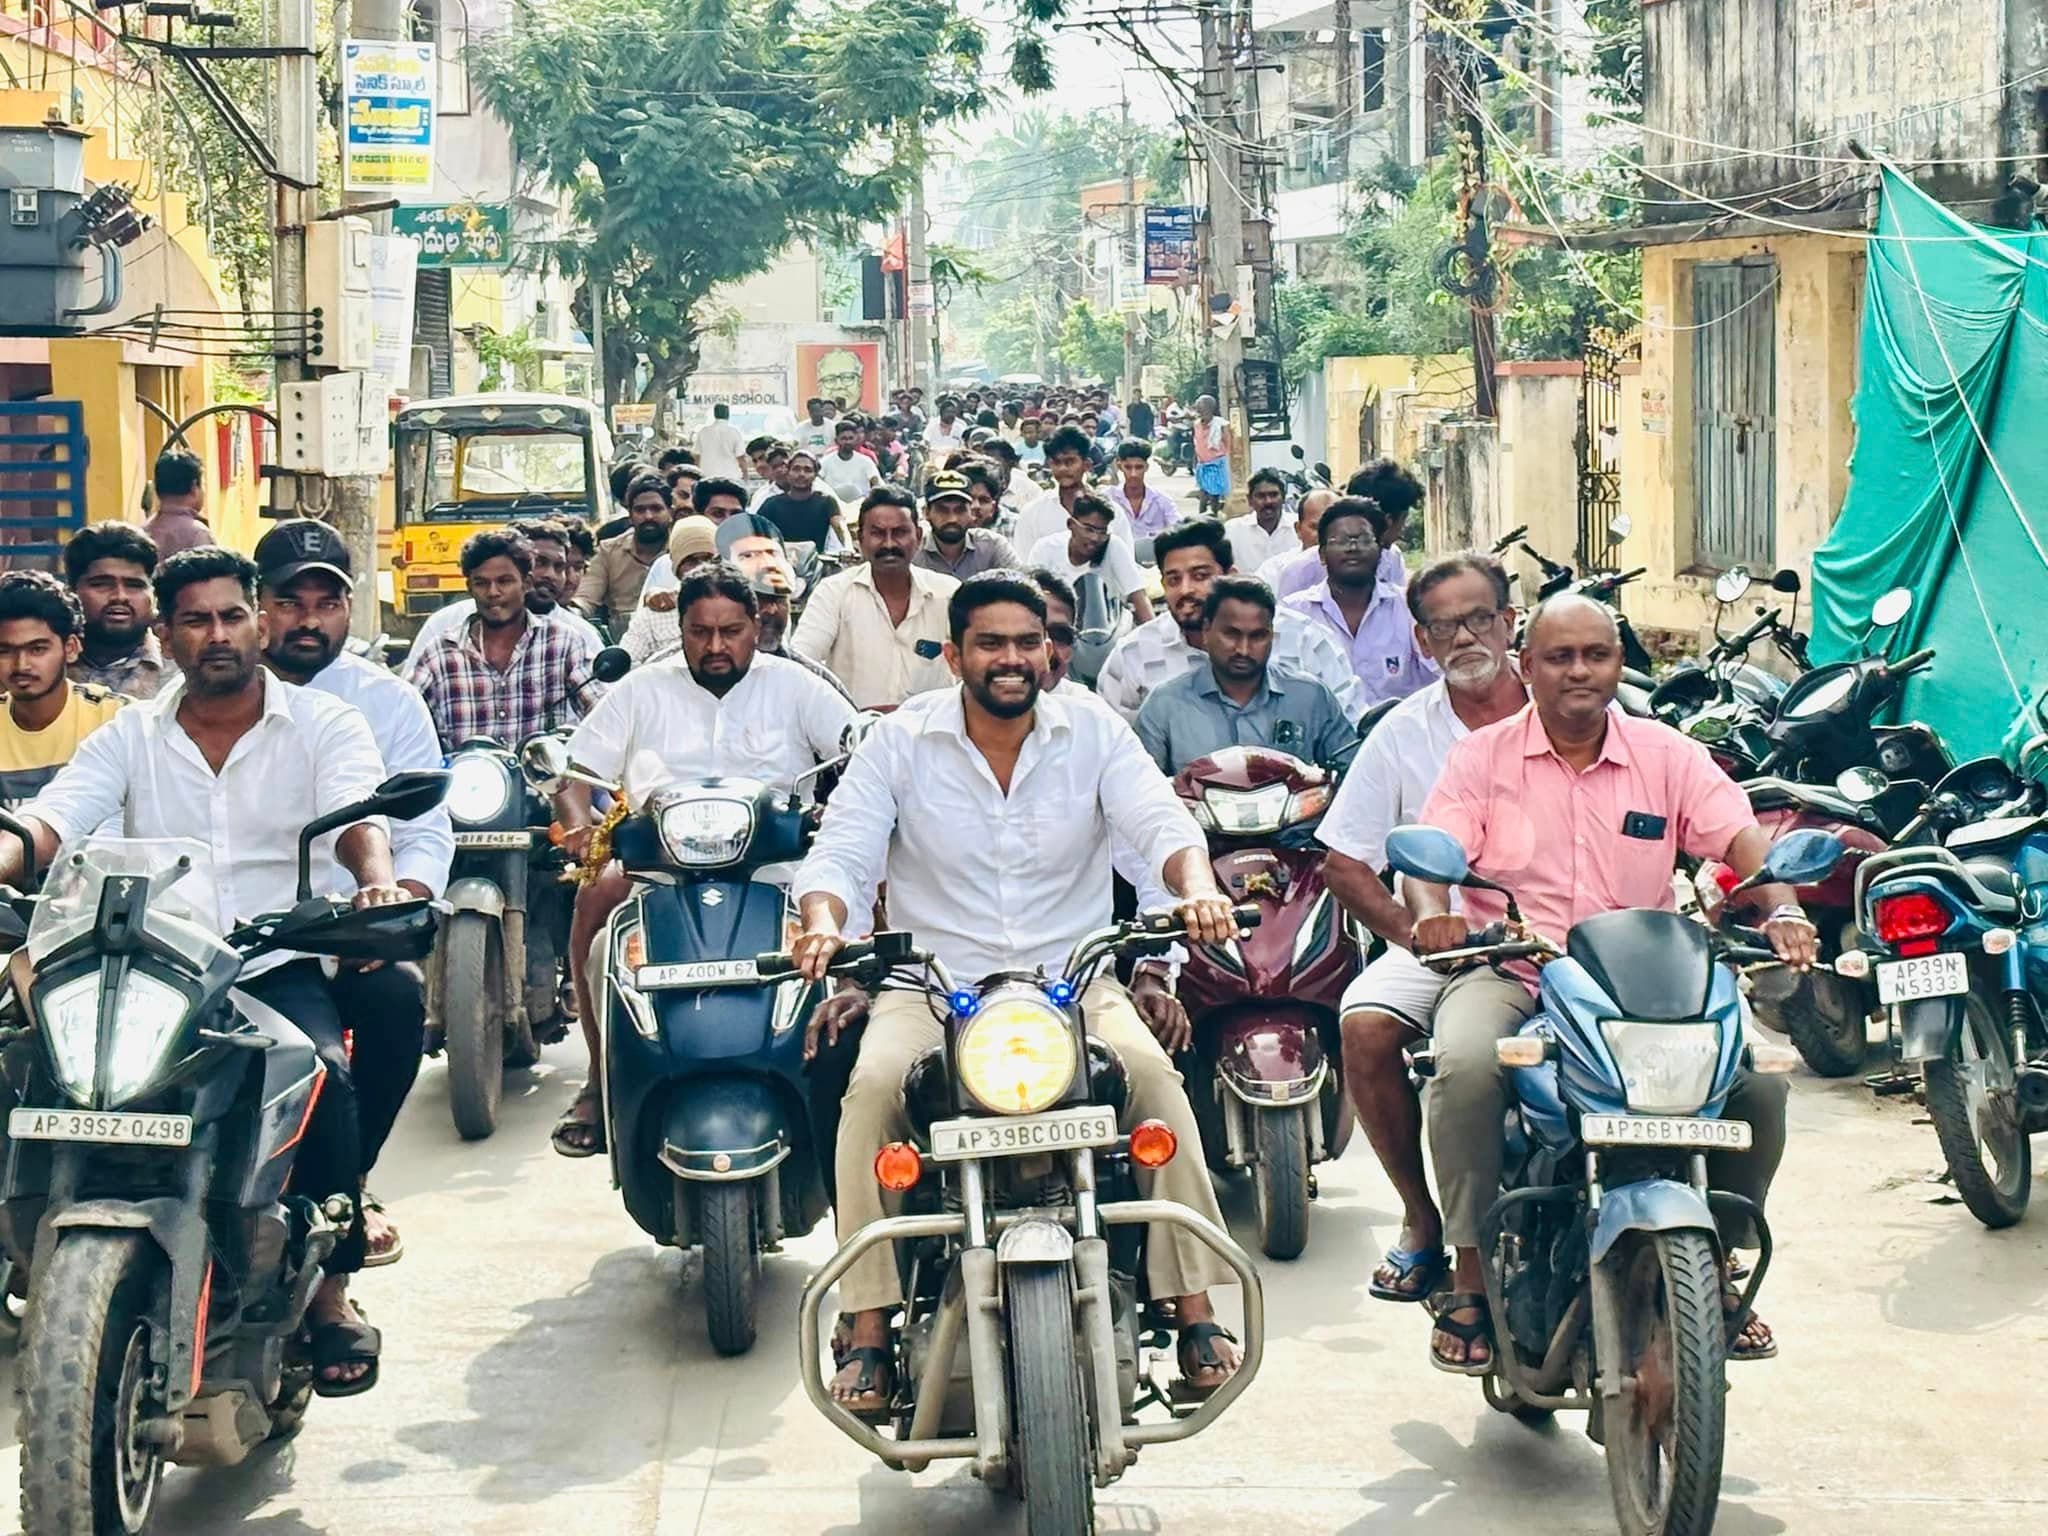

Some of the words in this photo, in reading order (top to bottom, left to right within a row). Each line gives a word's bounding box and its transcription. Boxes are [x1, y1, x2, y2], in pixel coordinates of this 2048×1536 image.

[731, 394, 778, 405] SCHOOL
[304, 532, 321, 552] E
[659, 967, 678, 980] AP
[33, 1115, 60, 1134] AP
[131, 1119, 186, 1140] 0498
